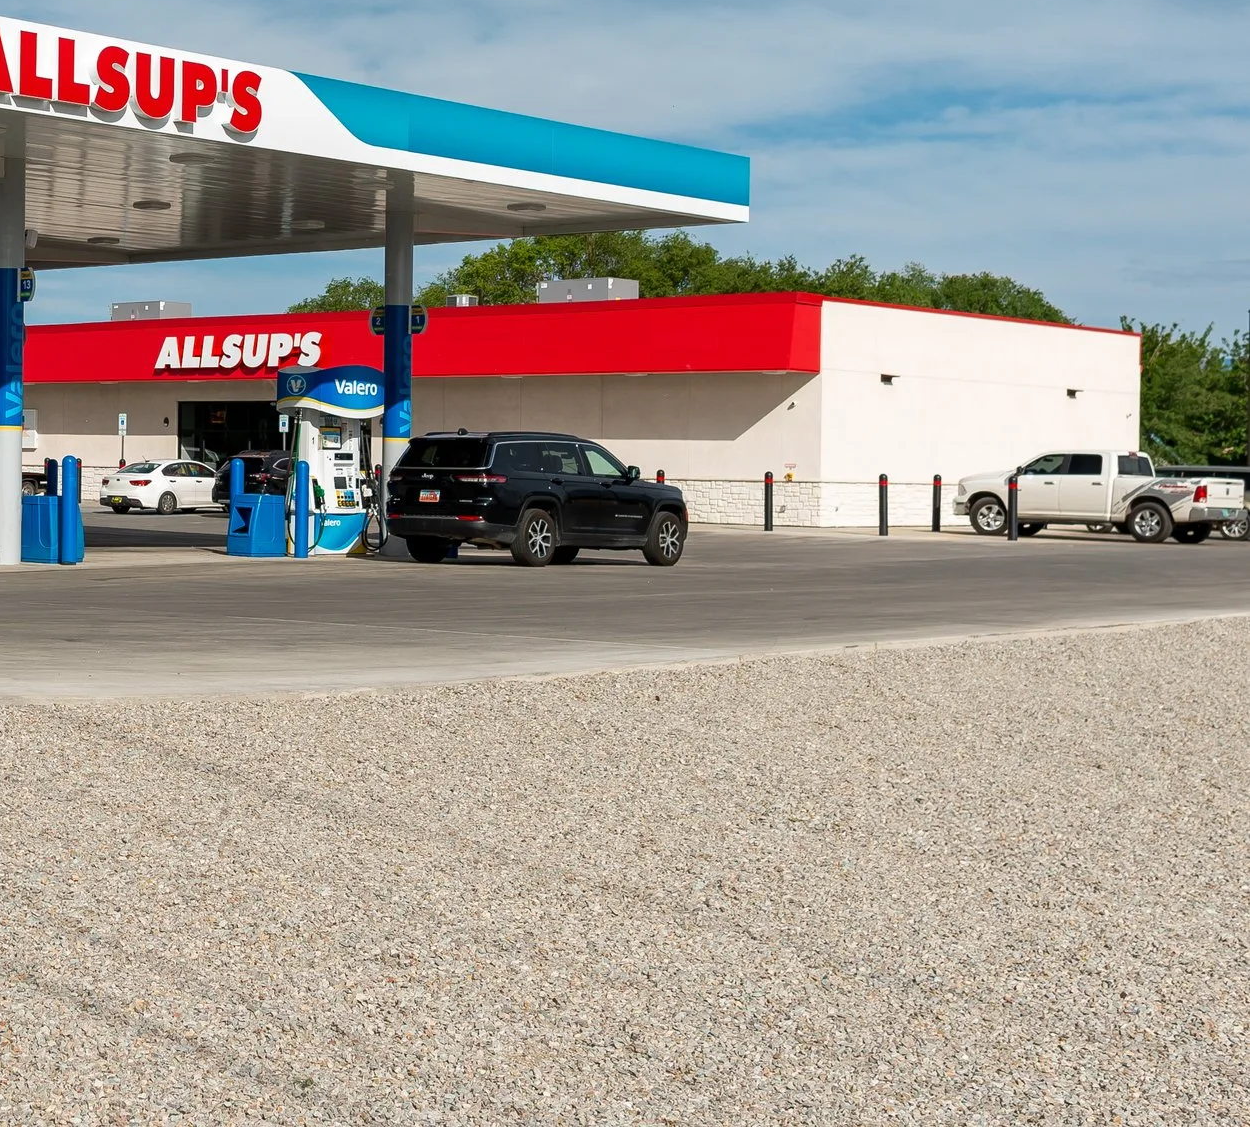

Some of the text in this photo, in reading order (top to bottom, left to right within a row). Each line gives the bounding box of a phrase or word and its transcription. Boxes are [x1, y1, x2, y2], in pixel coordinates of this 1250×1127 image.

[22, 279, 31, 290] 13
[154, 331, 323, 369] ALLSUP'S
[334, 378, 378, 396] Valero
